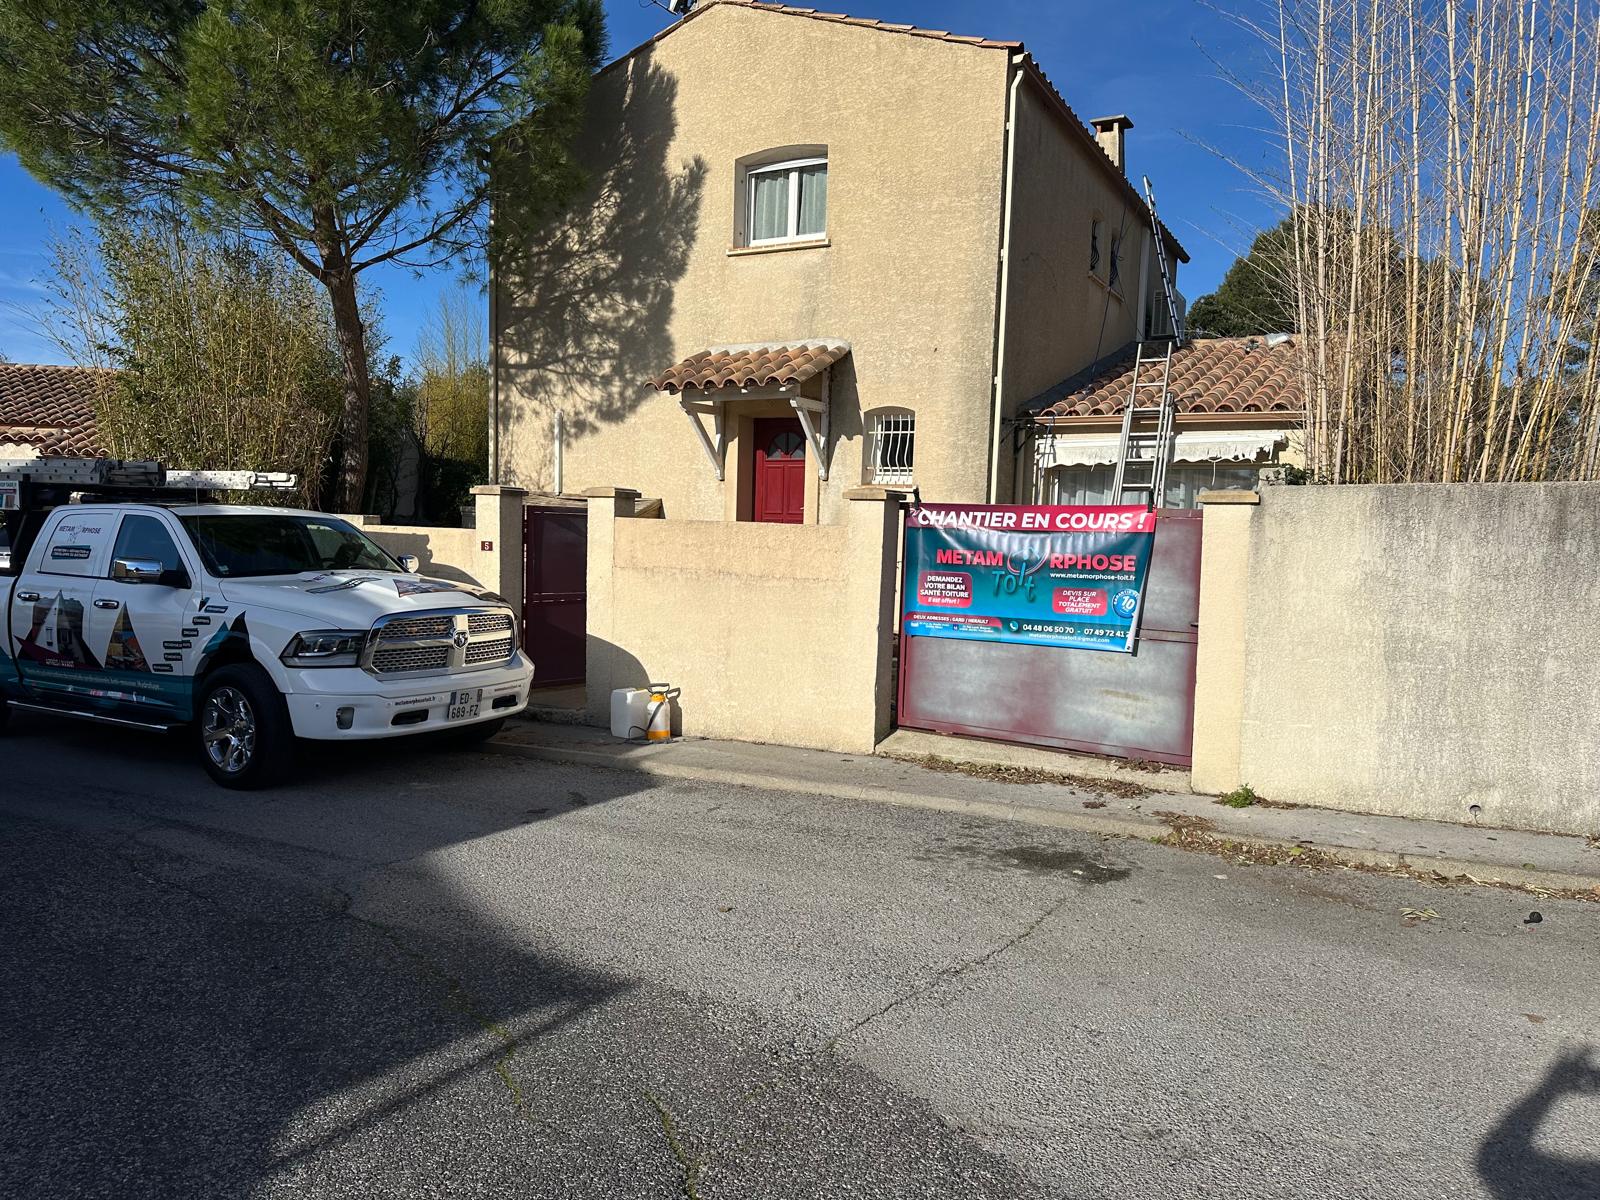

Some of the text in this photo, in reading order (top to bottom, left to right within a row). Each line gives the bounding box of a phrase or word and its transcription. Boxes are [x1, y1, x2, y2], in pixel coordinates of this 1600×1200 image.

[917, 510, 1017, 527] CHANTIER
[1021, 512, 1050, 528] EN
[1055, 512, 1134, 530] COURS
[484, 541, 490, 550] 5
[936, 549, 1137, 572] METAM RPHOSE
[927, 575, 963, 583] DEMANDEZ
[1049, 572, 1136, 581] www.metamorphose-toit.fr
[924, 582, 966, 591] VOTRE BILAN
[920, 588, 941, 597] SANTÉ
[1058, 601, 1102, 609] TOTALEMENT
[1121, 595, 1136, 610] 10
[1115, 630, 1124, 638] 41
[451, 704, 479, 719] 689-FZ
